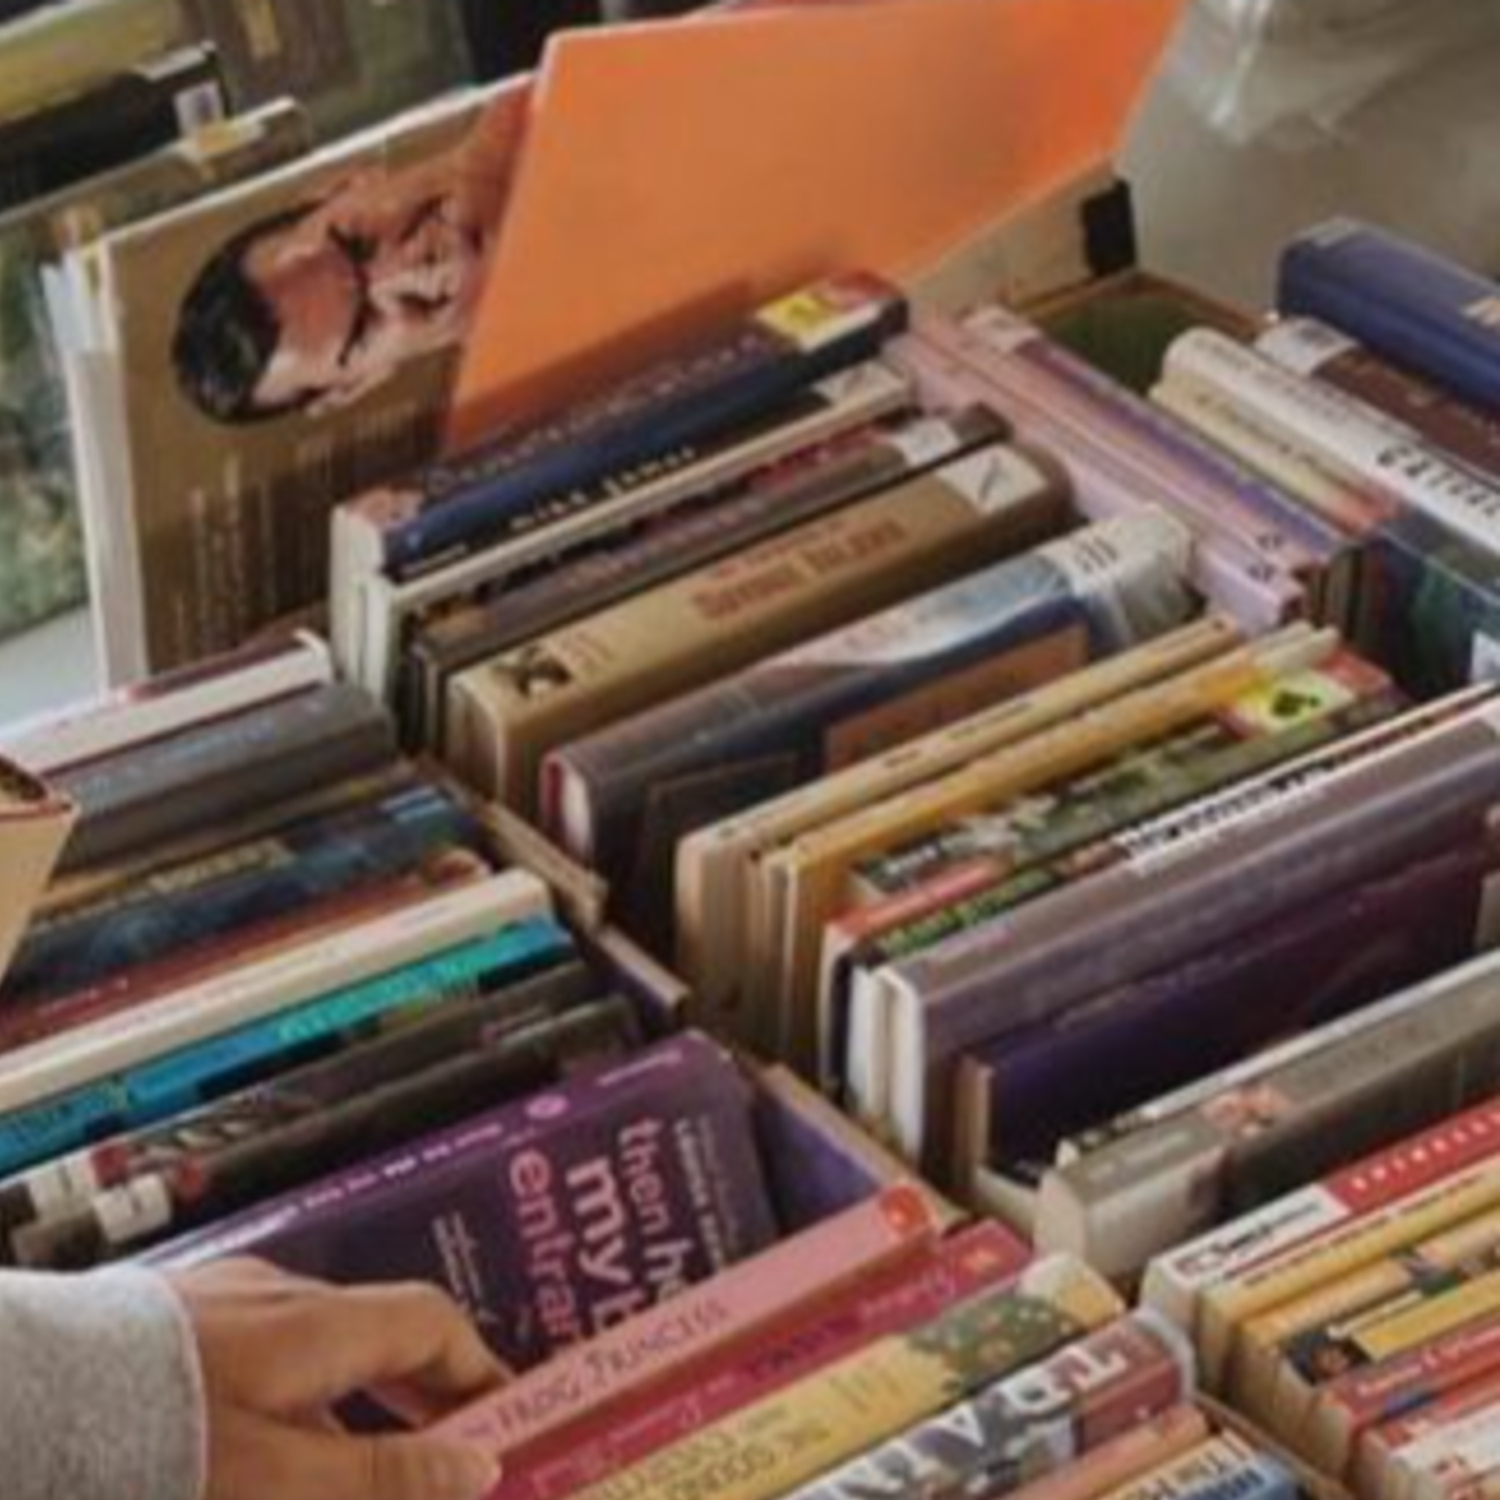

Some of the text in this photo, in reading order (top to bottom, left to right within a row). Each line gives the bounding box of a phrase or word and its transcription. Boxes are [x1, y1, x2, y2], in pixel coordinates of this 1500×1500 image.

[566, 1156, 631, 1285] my
[620, 1116, 673, 1237] then
[508, 1148, 584, 1340] entra
[1168, 1445, 1225, 1490] The
